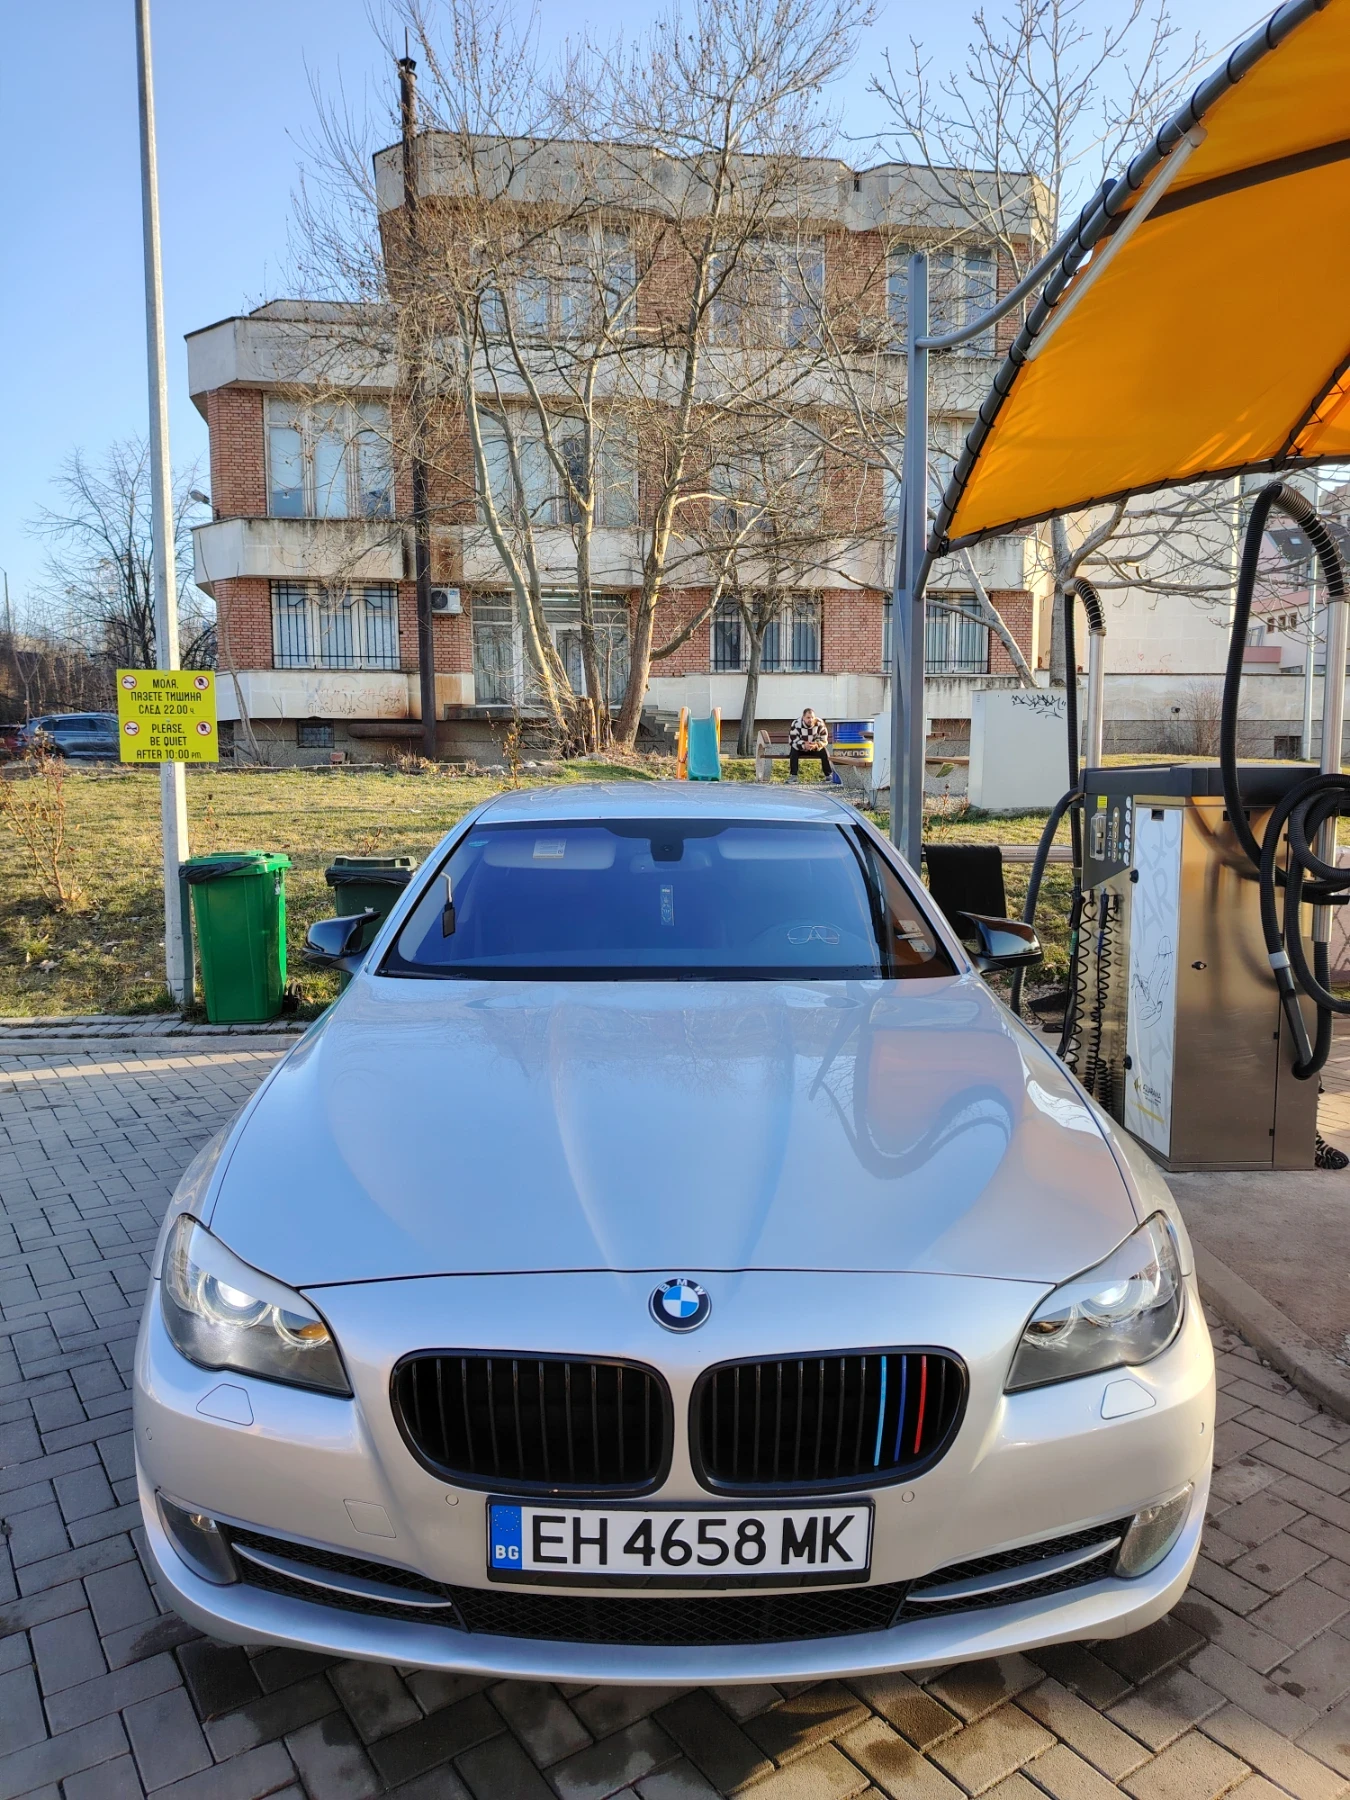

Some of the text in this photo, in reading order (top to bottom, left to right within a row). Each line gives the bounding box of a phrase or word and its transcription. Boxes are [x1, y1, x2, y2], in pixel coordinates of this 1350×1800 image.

[130, 692, 202, 702] ПАЗЕТЕ ТИШИНА
[138, 705, 161, 715] СЛЕД
[163, 705, 188, 714] 22.00
[150, 736, 187, 747] BE QUIET
[136, 750, 162, 759] AFTER
[165, 749, 189, 759] 10:00
[658, 1278, 706, 1295] BMW
[531, 1514, 856, 1568] EH 4658 MK
[495, 1545, 519, 1560] BG
